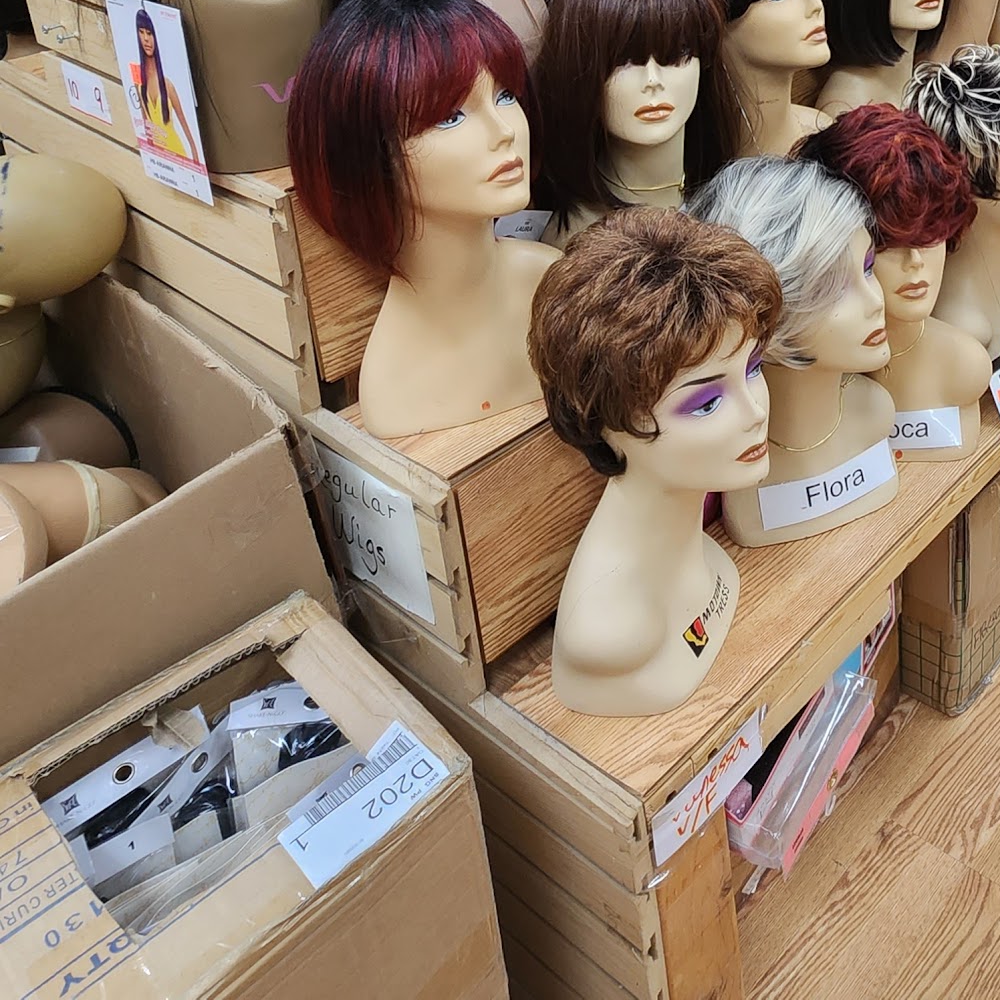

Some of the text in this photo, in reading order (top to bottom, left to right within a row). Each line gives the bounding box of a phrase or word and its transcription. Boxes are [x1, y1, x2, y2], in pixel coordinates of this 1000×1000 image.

[67, 78, 104, 114] 10 9
[322, 469, 397, 518] egular
[804, 467, 866, 507] Flora
[332, 503, 386, 576] Wigs
[714, 583, 730, 619] TRESS
[361, 757, 434, 820] D202
[127, 840, 136, 851] 1
[59, 932, 133, 998] QTY
